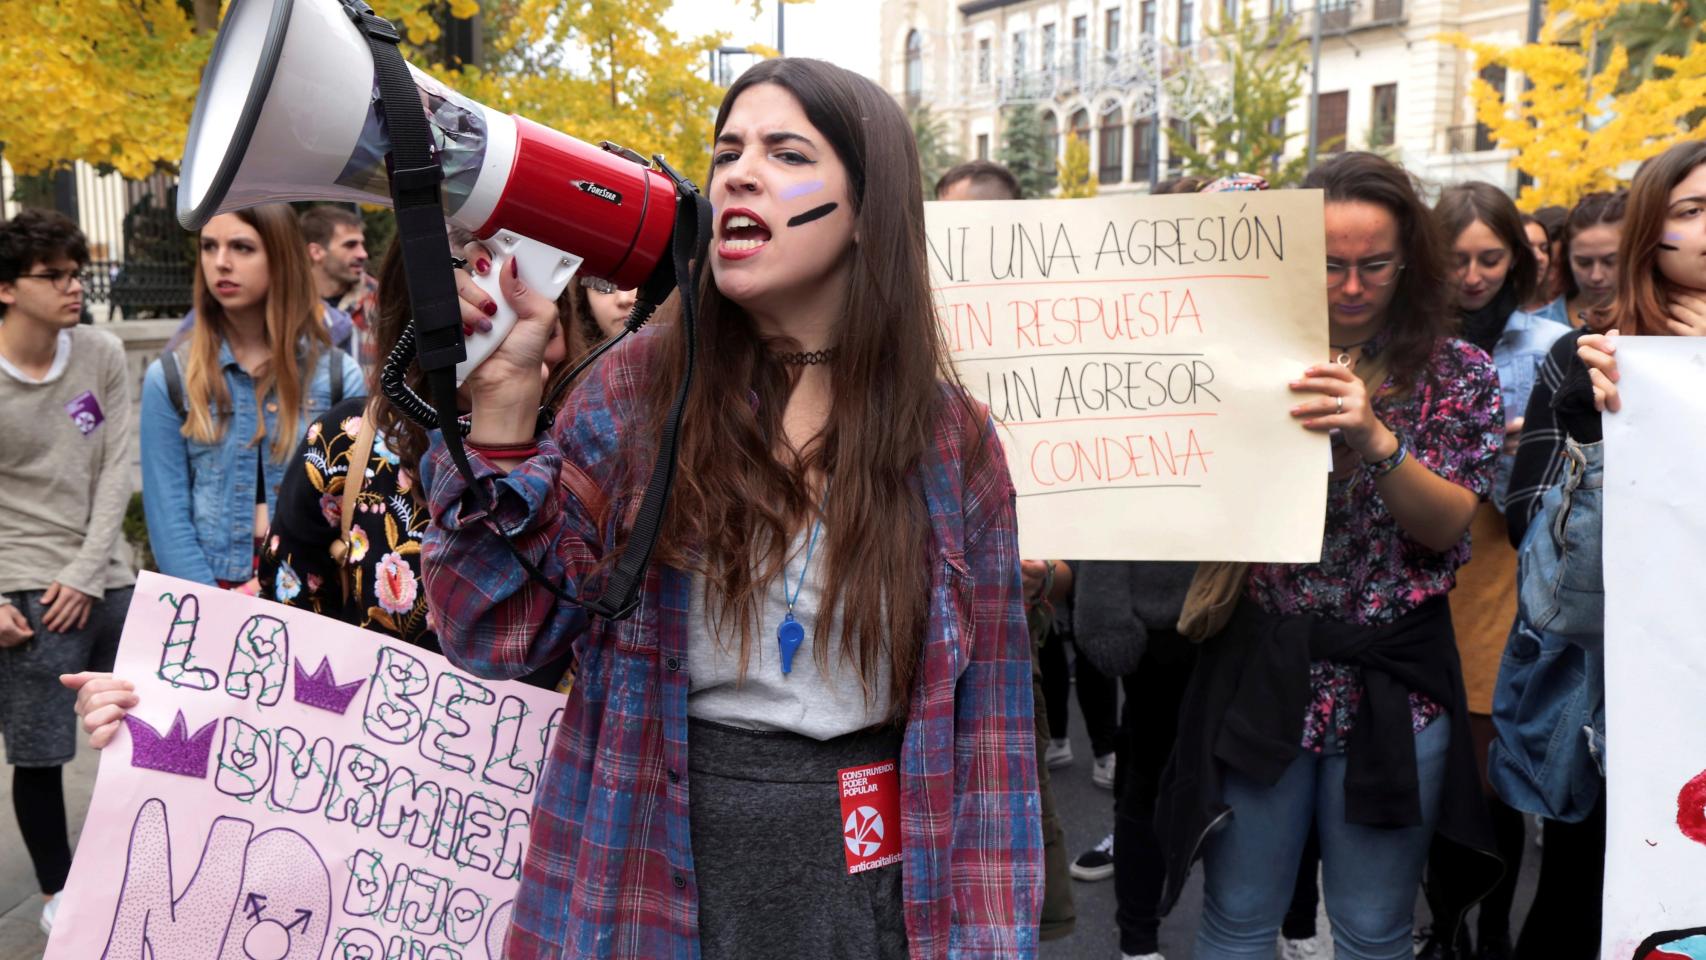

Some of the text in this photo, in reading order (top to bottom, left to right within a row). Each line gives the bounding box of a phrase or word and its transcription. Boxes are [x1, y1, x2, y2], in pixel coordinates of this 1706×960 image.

[925, 202, 1284, 282] NI UNA AGRESIÓN
[1008, 288, 1203, 350] RESPUESTA
[986, 360, 1222, 423] UN AGRESOR
[1031, 428, 1215, 486] CONDENA
[158, 593, 290, 707] LA
[842, 763, 894, 780] CONSTRUYENDO
[843, 777, 868, 789] PODER
[843, 783, 878, 798] POPULAR
[100, 797, 332, 960] NO
[342, 848, 486, 945] DIJO
